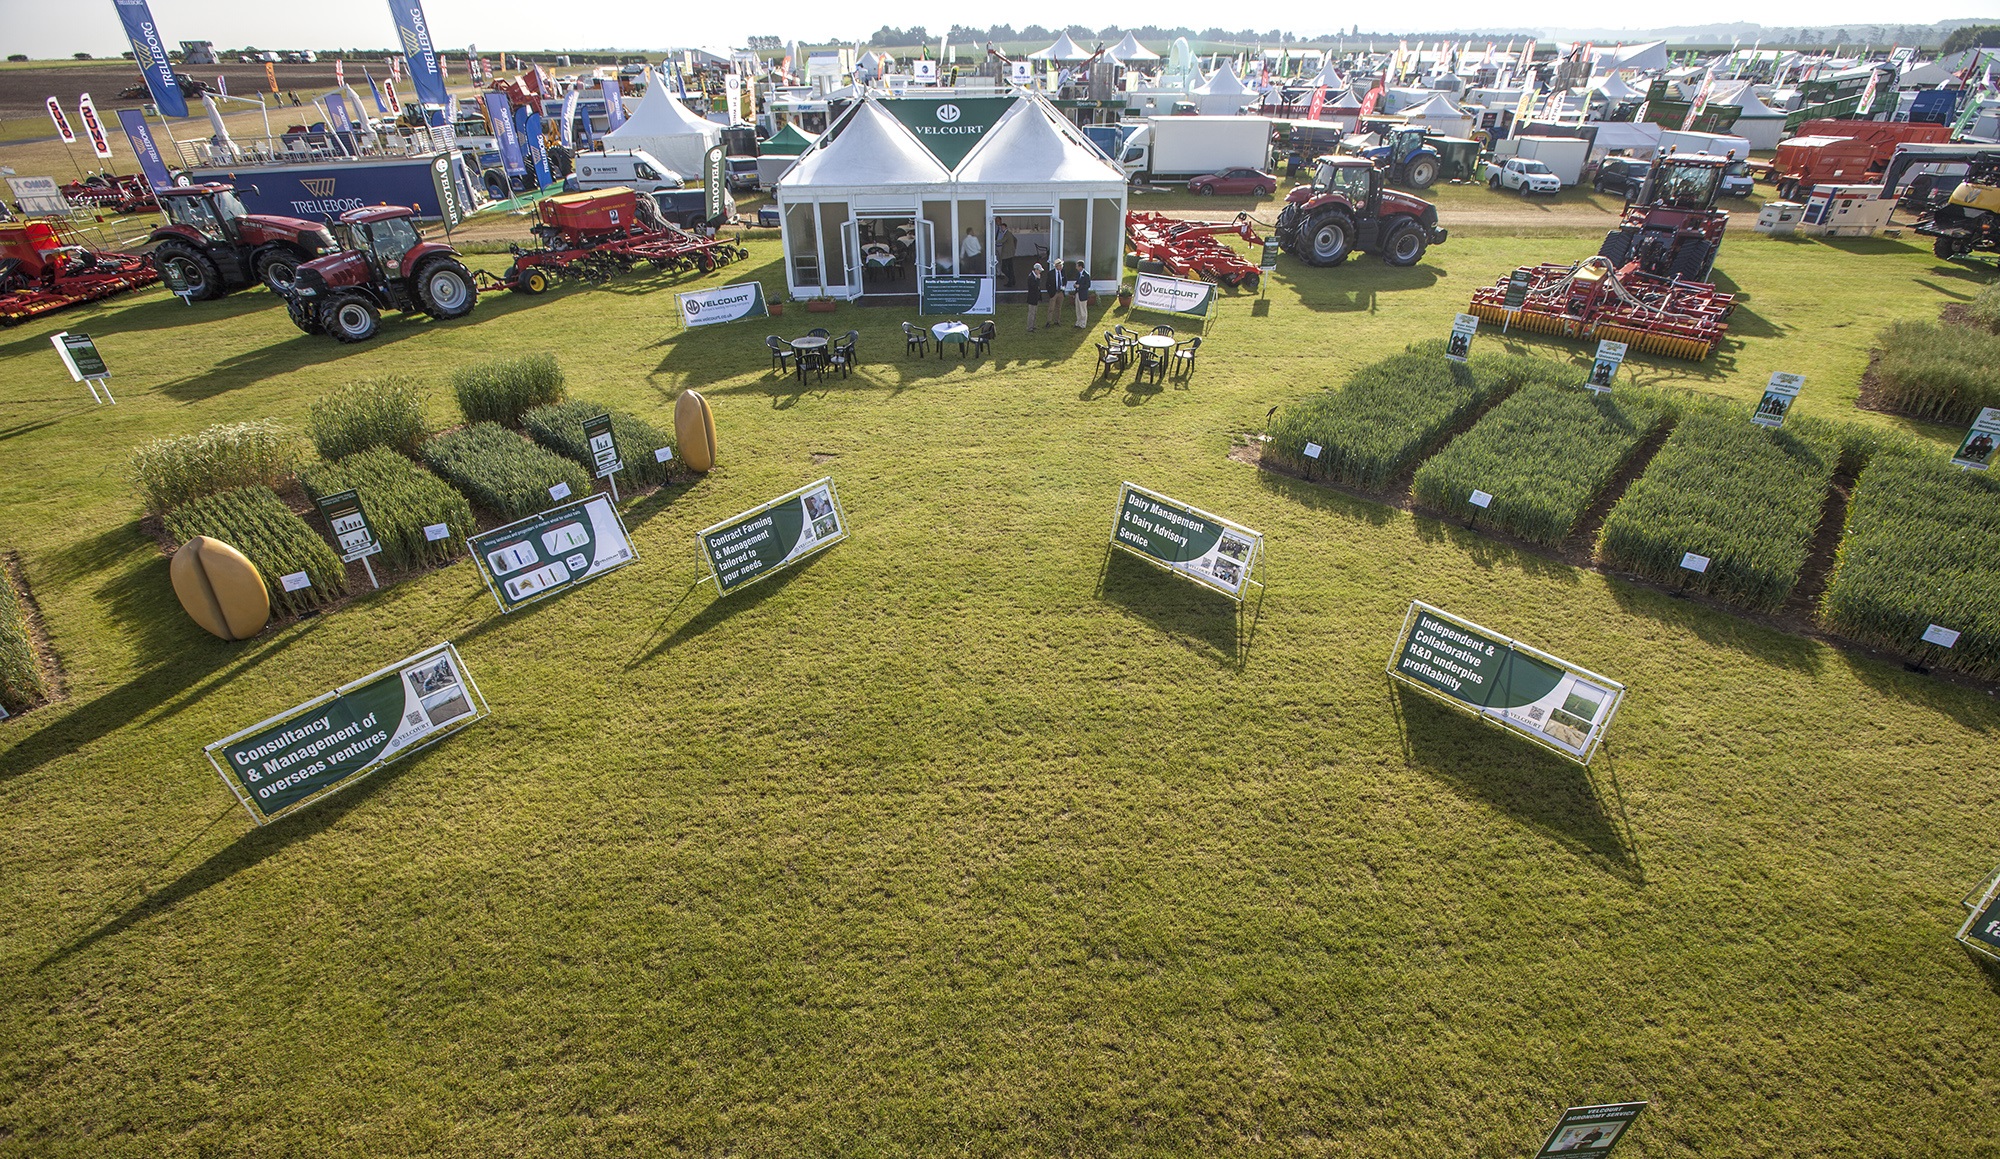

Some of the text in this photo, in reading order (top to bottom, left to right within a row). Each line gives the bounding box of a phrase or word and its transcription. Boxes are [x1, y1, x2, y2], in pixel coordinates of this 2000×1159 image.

[140, 22, 176, 87] TRELLEBORG
[410, 8, 436, 74] TRELLEBORG
[49, 101, 72, 138] SUMO
[500, 107, 515, 145] TRELLEBORG
[915, 126, 984, 135] VELCOURT
[138, 125, 159, 164] TRELLEBORG
[537, 134, 550, 173] TRELLEBORG
[440, 172, 458, 225] VELCOURT
[712, 162, 720, 214] VELCOURT
[291, 198, 364, 215] TRELLEBORG
[610, 210, 618, 221] 2
[700, 294, 748, 308] VELCOURT
[1153, 286, 1199, 298] VELCOURT
[1756, 413, 1782, 422] WINNER
[1124, 510, 1188, 548] & Dairy Advisory
[1128, 494, 1204, 533] Dairy Management
[710, 516, 773, 548] Contract Farming
[714, 530, 770, 560] & Management
[1120, 527, 1148, 547] Service
[718, 548, 757, 572] tailored to
[722, 560, 762, 584] your needs
[1415, 630, 1482, 667] Collaborative
[1420, 616, 1495, 656] Independent &
[1402, 658, 1462, 692] profitability
[1409, 644, 1484, 685] R&D underpins
[397, 722, 430, 740] VELCOURT
[1510, 712, 1542, 729] VELCOURT
[234, 714, 332, 766] Consultancy
[246, 712, 378, 783] & Management of
[258, 729, 388, 799] overseas ventures
[1566, 1110, 1636, 1122] AGRONOMY SERVICE
[1587, 1106, 1624, 1114] VELCOURT
